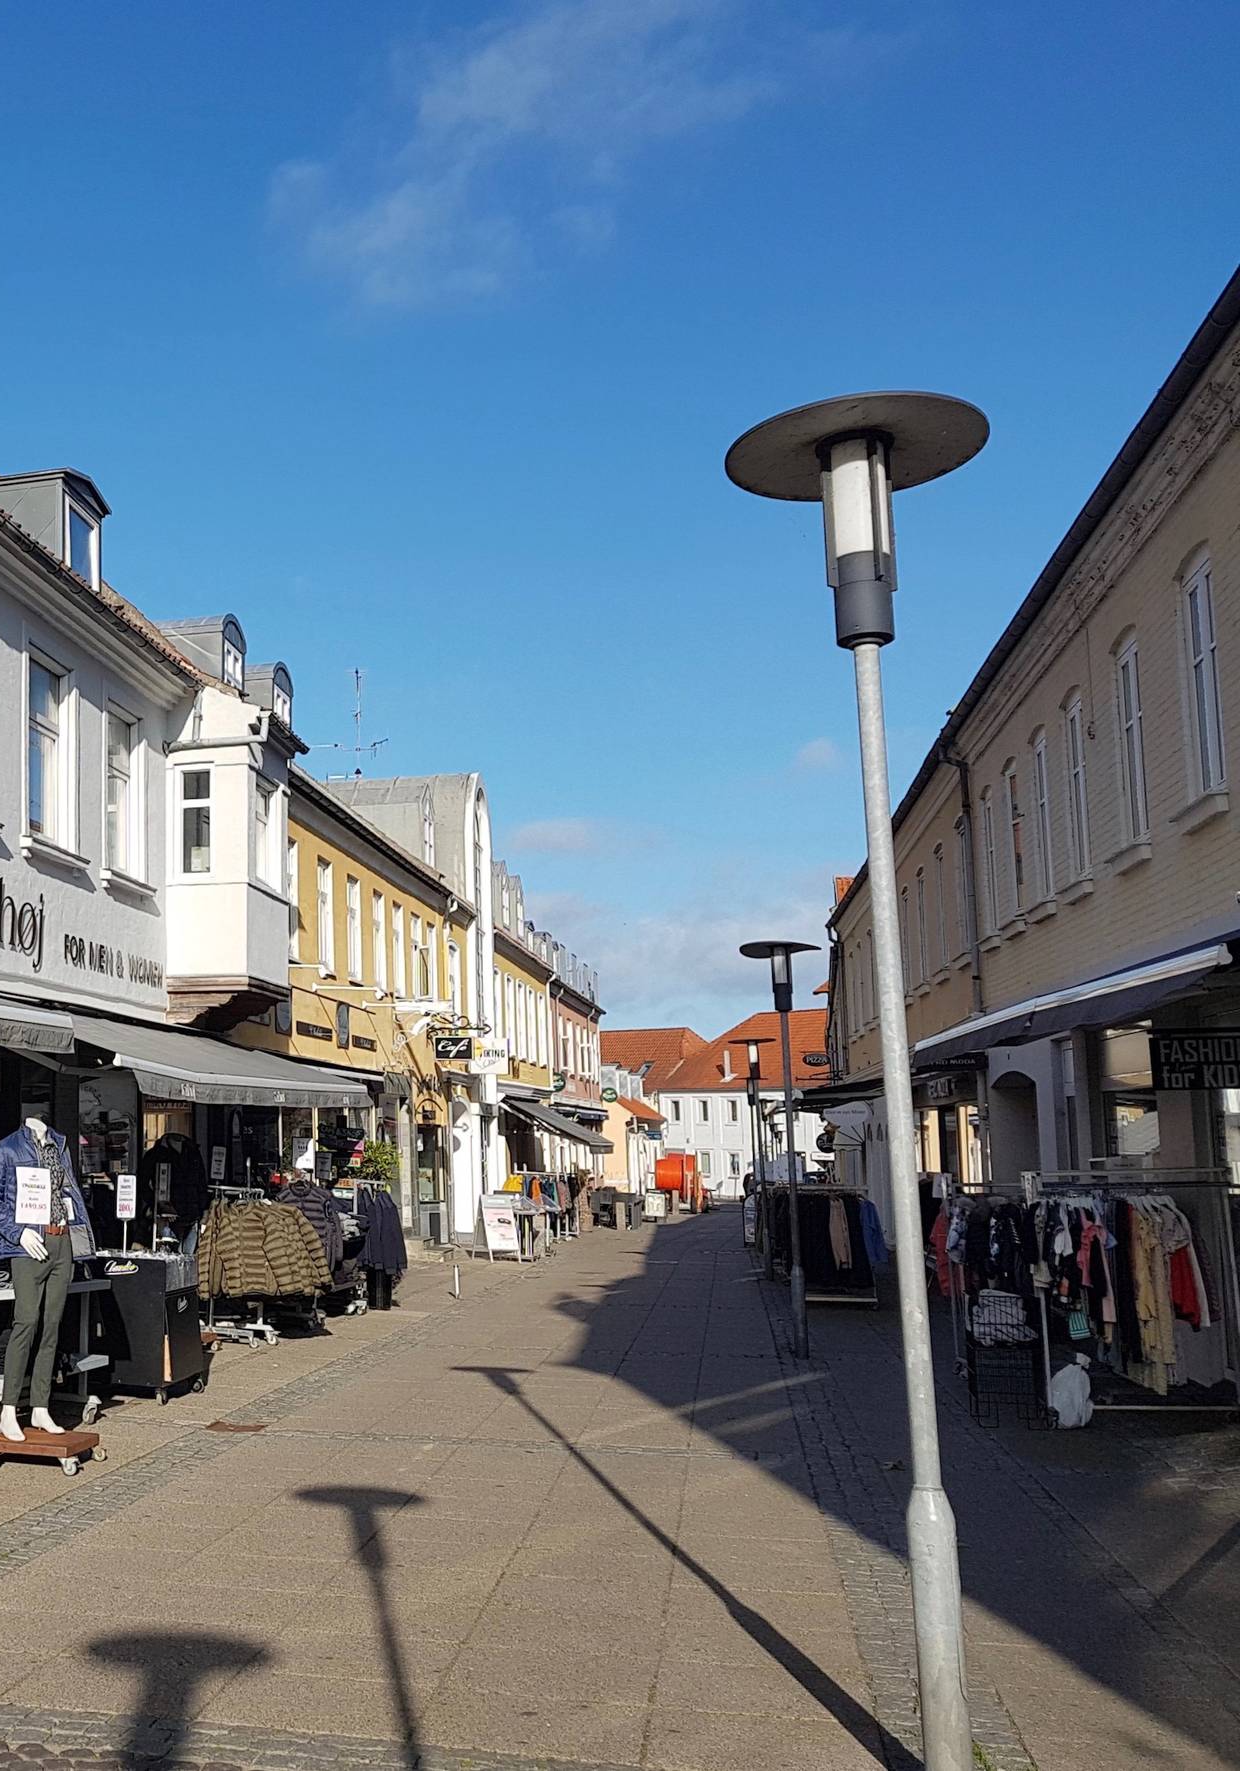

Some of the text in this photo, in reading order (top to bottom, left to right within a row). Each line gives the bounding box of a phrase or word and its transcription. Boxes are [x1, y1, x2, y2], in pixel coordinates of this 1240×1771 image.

[64, 933, 163, 990] FOR MEN & WOMEN
[806, 1056, 828, 1064] PIZZA
[1160, 1038, 1240, 1063] FASHIO
[1162, 1065, 1195, 1089] for
[1203, 1064, 1240, 1088] KID
